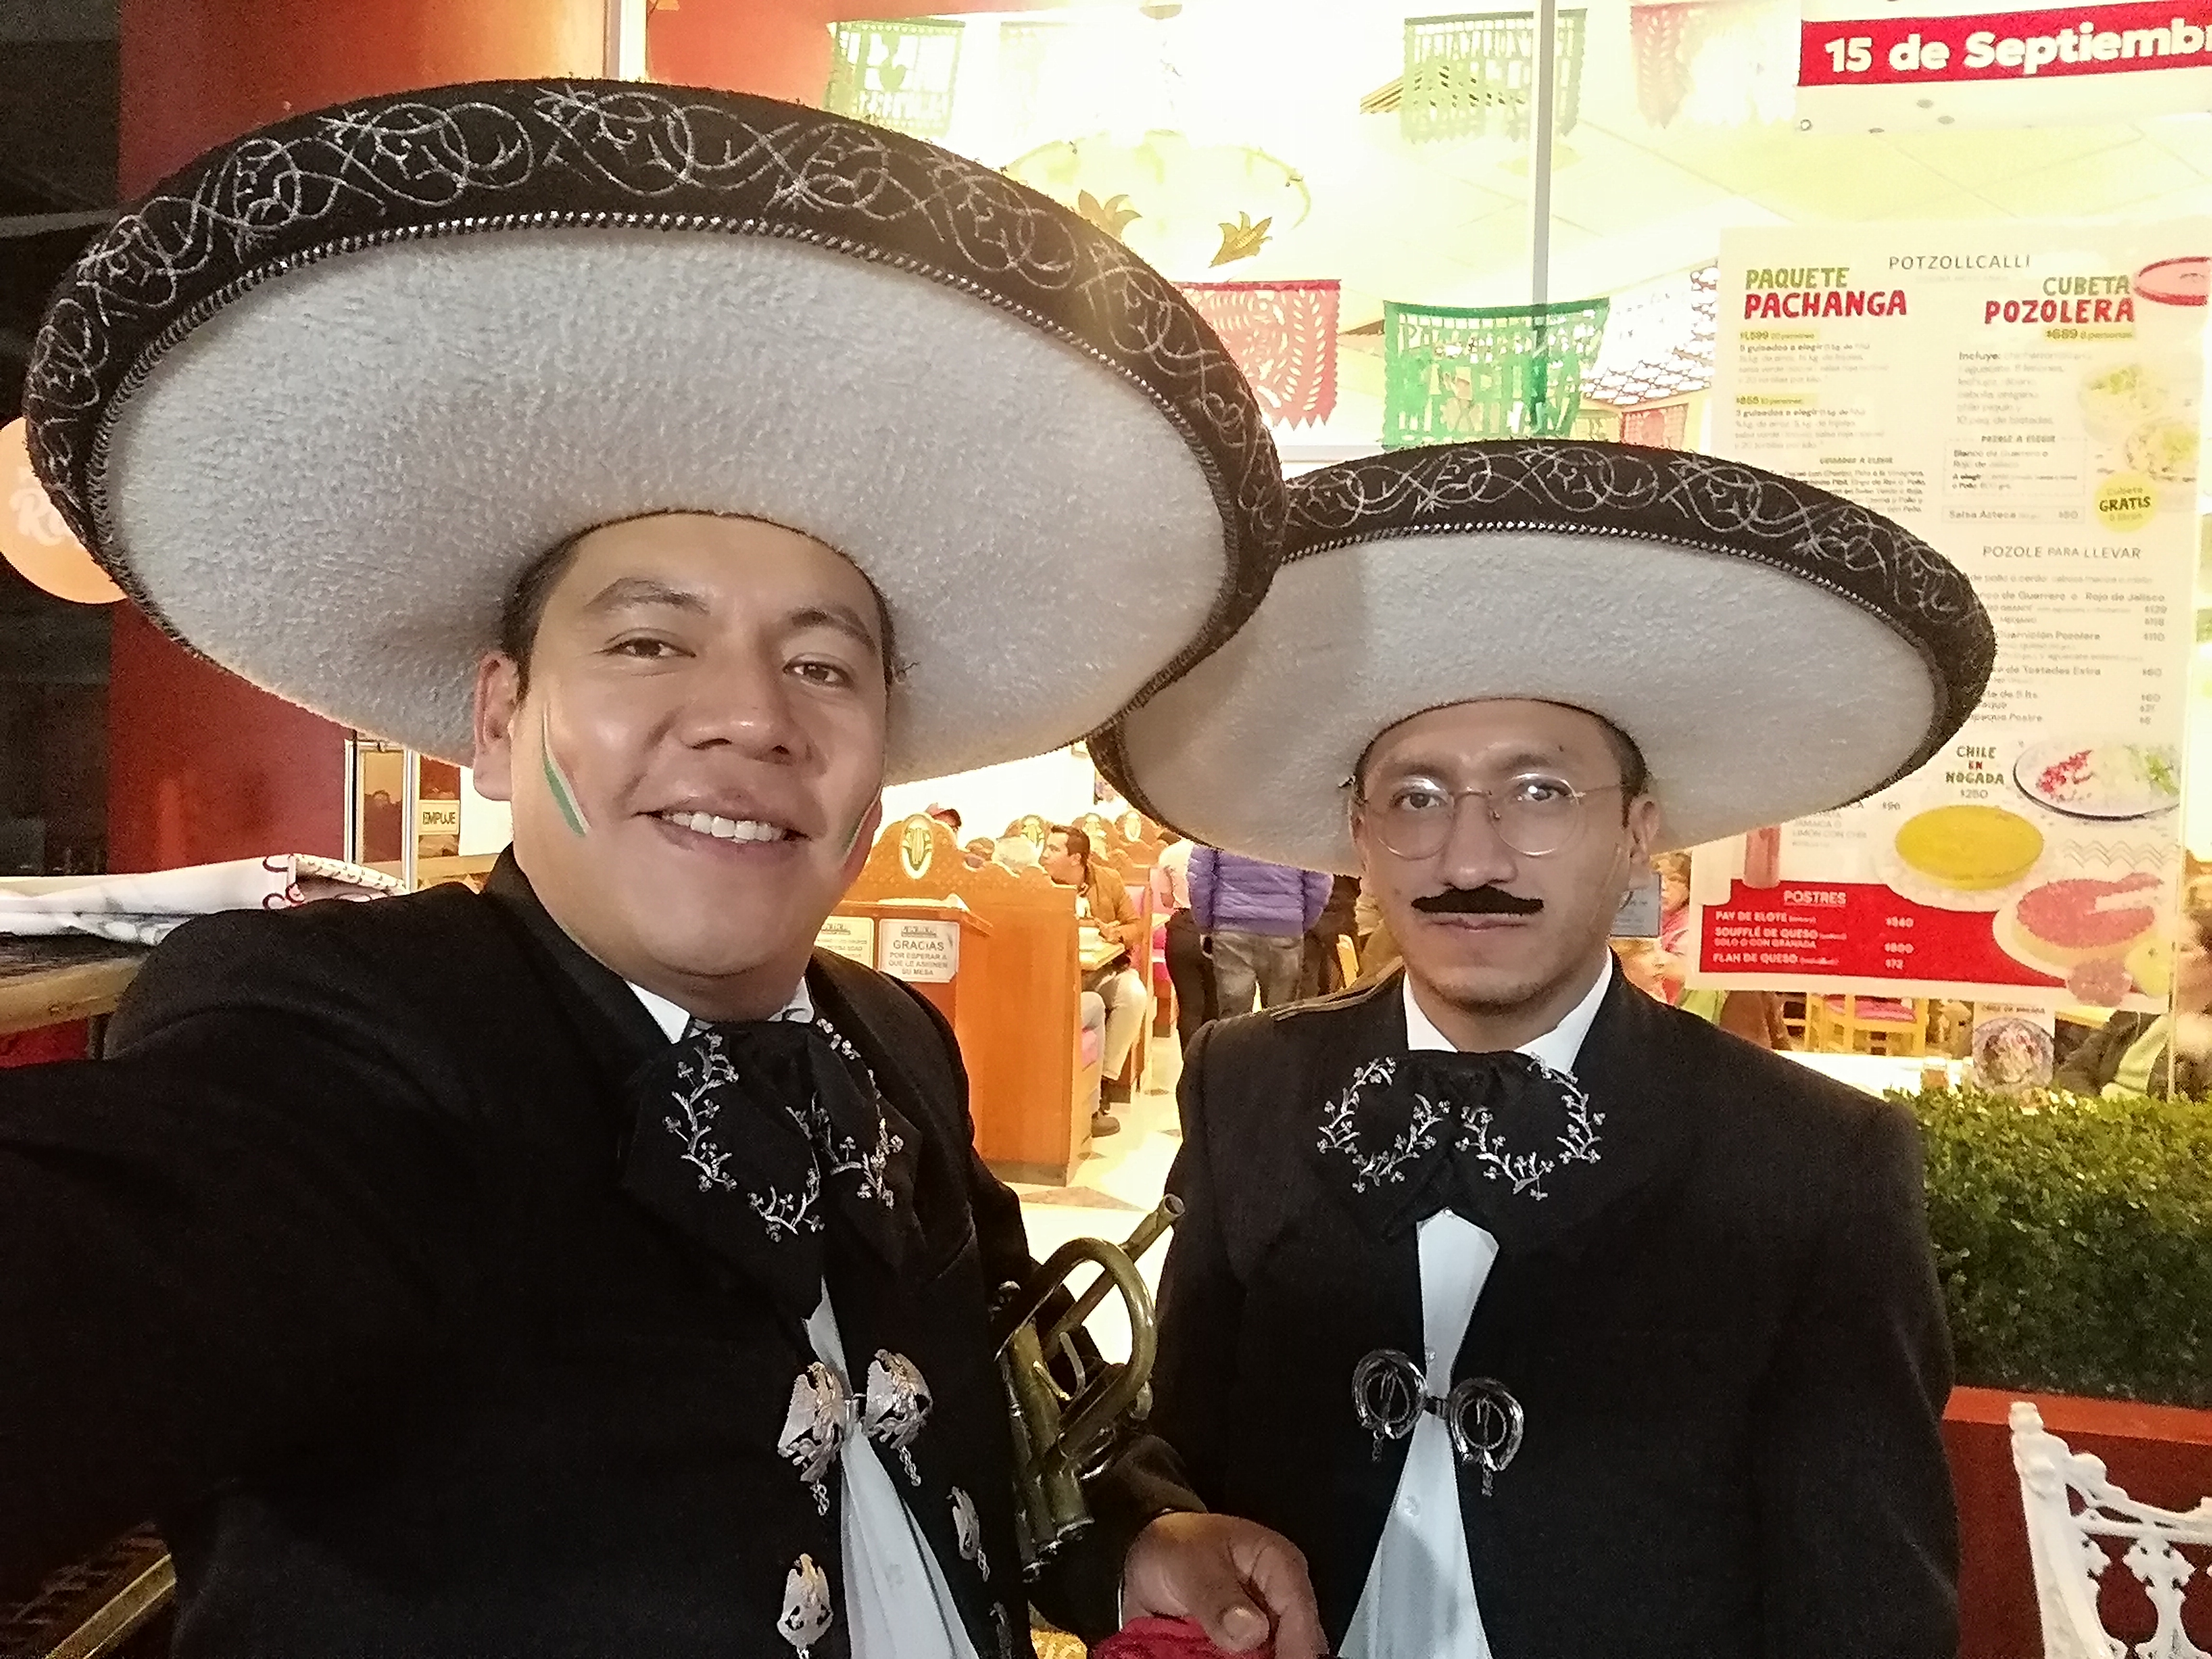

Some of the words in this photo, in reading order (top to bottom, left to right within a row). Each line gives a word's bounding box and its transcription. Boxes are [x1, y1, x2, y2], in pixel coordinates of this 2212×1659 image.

[1825, 38, 1872, 72] 15
[1888, 34, 1949, 71] de
[1889, 254, 2030, 270] POTZOLLCALLI
[1745, 267, 1850, 289] PAQUETE
[2042, 275, 2130, 296] CUBETA
[1744, 289, 1907, 320] PACHANGA
[1984, 297, 2135, 325] POZOLERA
[1959, 351, 2001, 361] Incluye:
[2099, 496, 2151, 513] GRATIS
[1983, 546, 2043, 558] POZOLE
[2047, 547, 2080, 557] PARA
[2084, 547, 2142, 559] LLEVAR
[2018, 591, 2066, 601] Guerrero
[2085, 592, 2108, 602] Rojo
[1956, 745, 1996, 759] CHILE
[1968, 760, 1983, 770] EN
[1945, 771, 2005, 784] NOGADA
[422, 811, 456, 825] EMPUJE
[1783, 890, 1847, 905] POSTRES
[1715, 910, 1736, 921] PAY
[1737, 911, 1752, 922] DE
[1754, 911, 1788, 923] ELOTE
[1714, 926, 1761, 938] SOUFFLÉ
[1763, 927, 1778, 938] DE
[1780, 928, 1818, 940] QUESO
[893, 940, 944, 951] GRACIAS
[1771, 939, 1817, 950] GRANADA
[1713, 952, 1741, 963] FLAN
[1743, 952, 1757, 963] DE
[1760, 953, 1799, 964] QUESO
